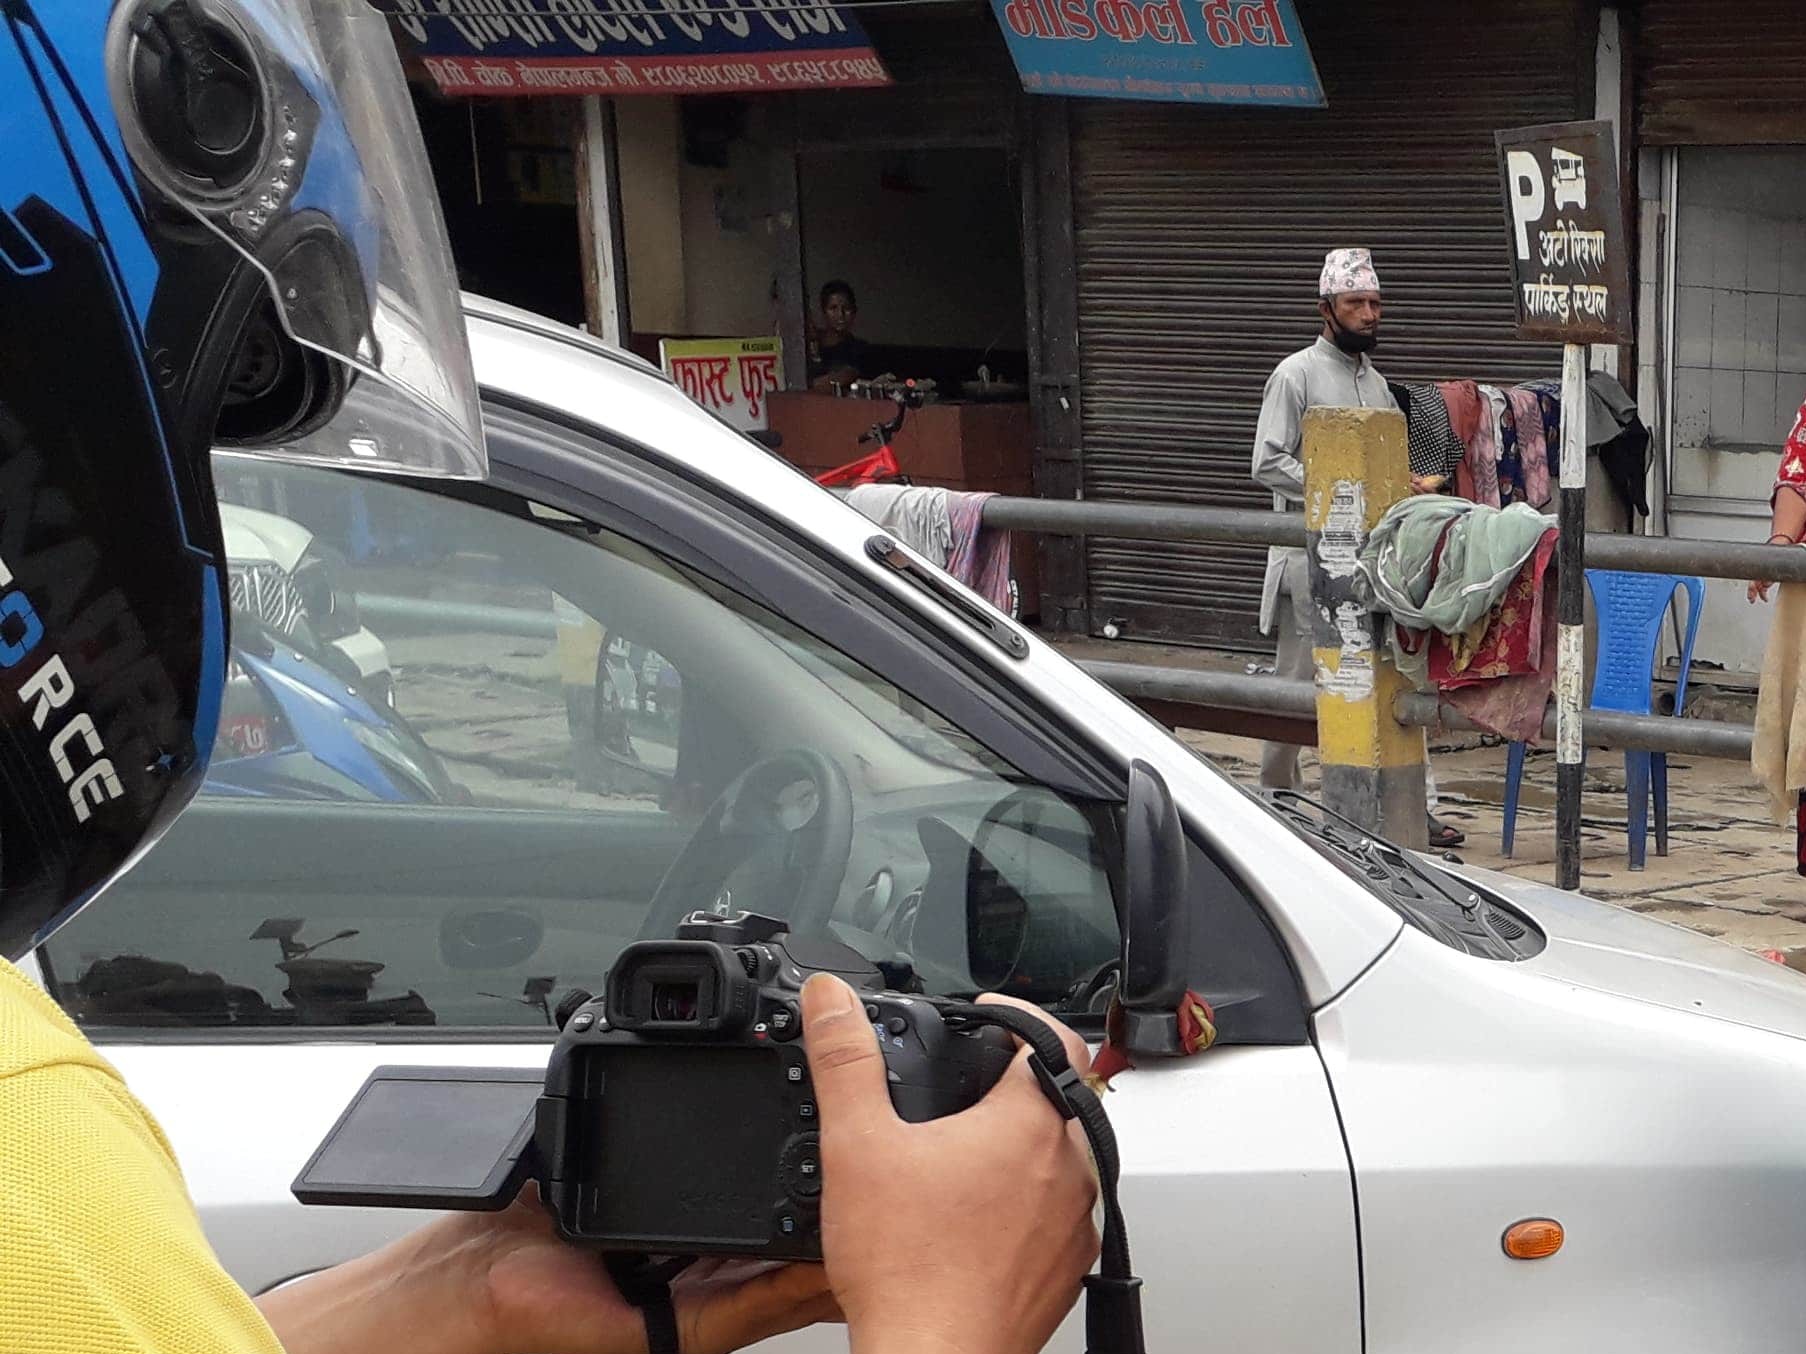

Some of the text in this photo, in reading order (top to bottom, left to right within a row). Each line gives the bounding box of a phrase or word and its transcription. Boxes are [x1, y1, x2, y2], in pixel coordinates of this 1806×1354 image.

[1507, 150, 1545, 260] P
[1539, 218, 1568, 267] अटो
[1572, 284, 1609, 324] स्थल
[0, 555, 125, 825] ORCE
